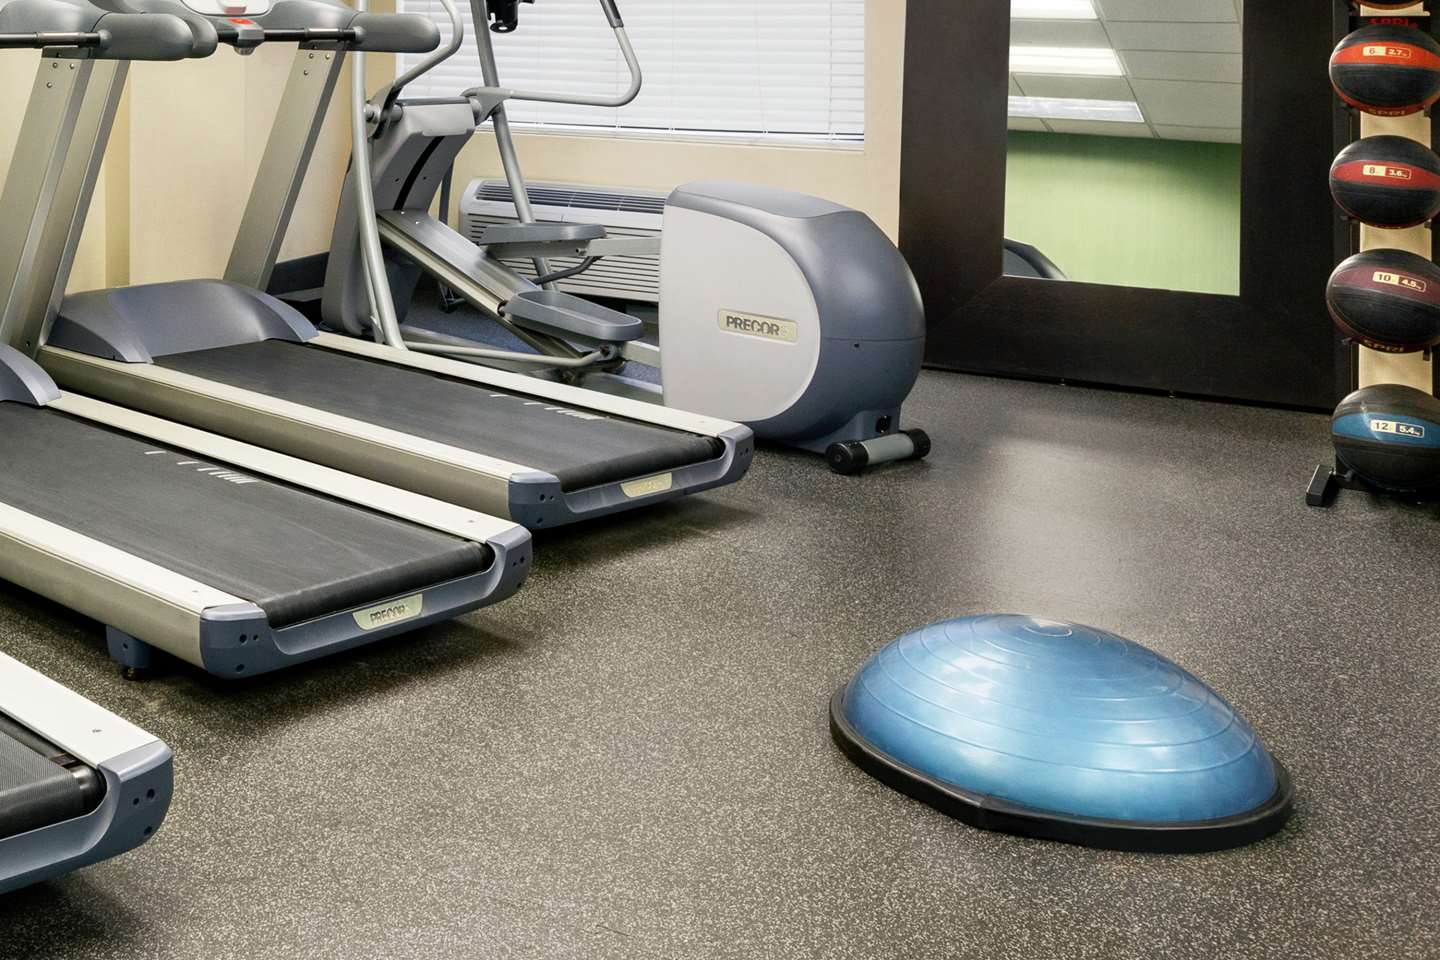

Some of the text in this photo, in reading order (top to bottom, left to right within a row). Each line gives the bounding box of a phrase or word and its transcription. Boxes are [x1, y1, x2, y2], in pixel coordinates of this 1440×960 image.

[1378, 274, 1392, 282] 10
[726, 315, 780, 336] PRECOR
[1375, 421, 1389, 430] 12
